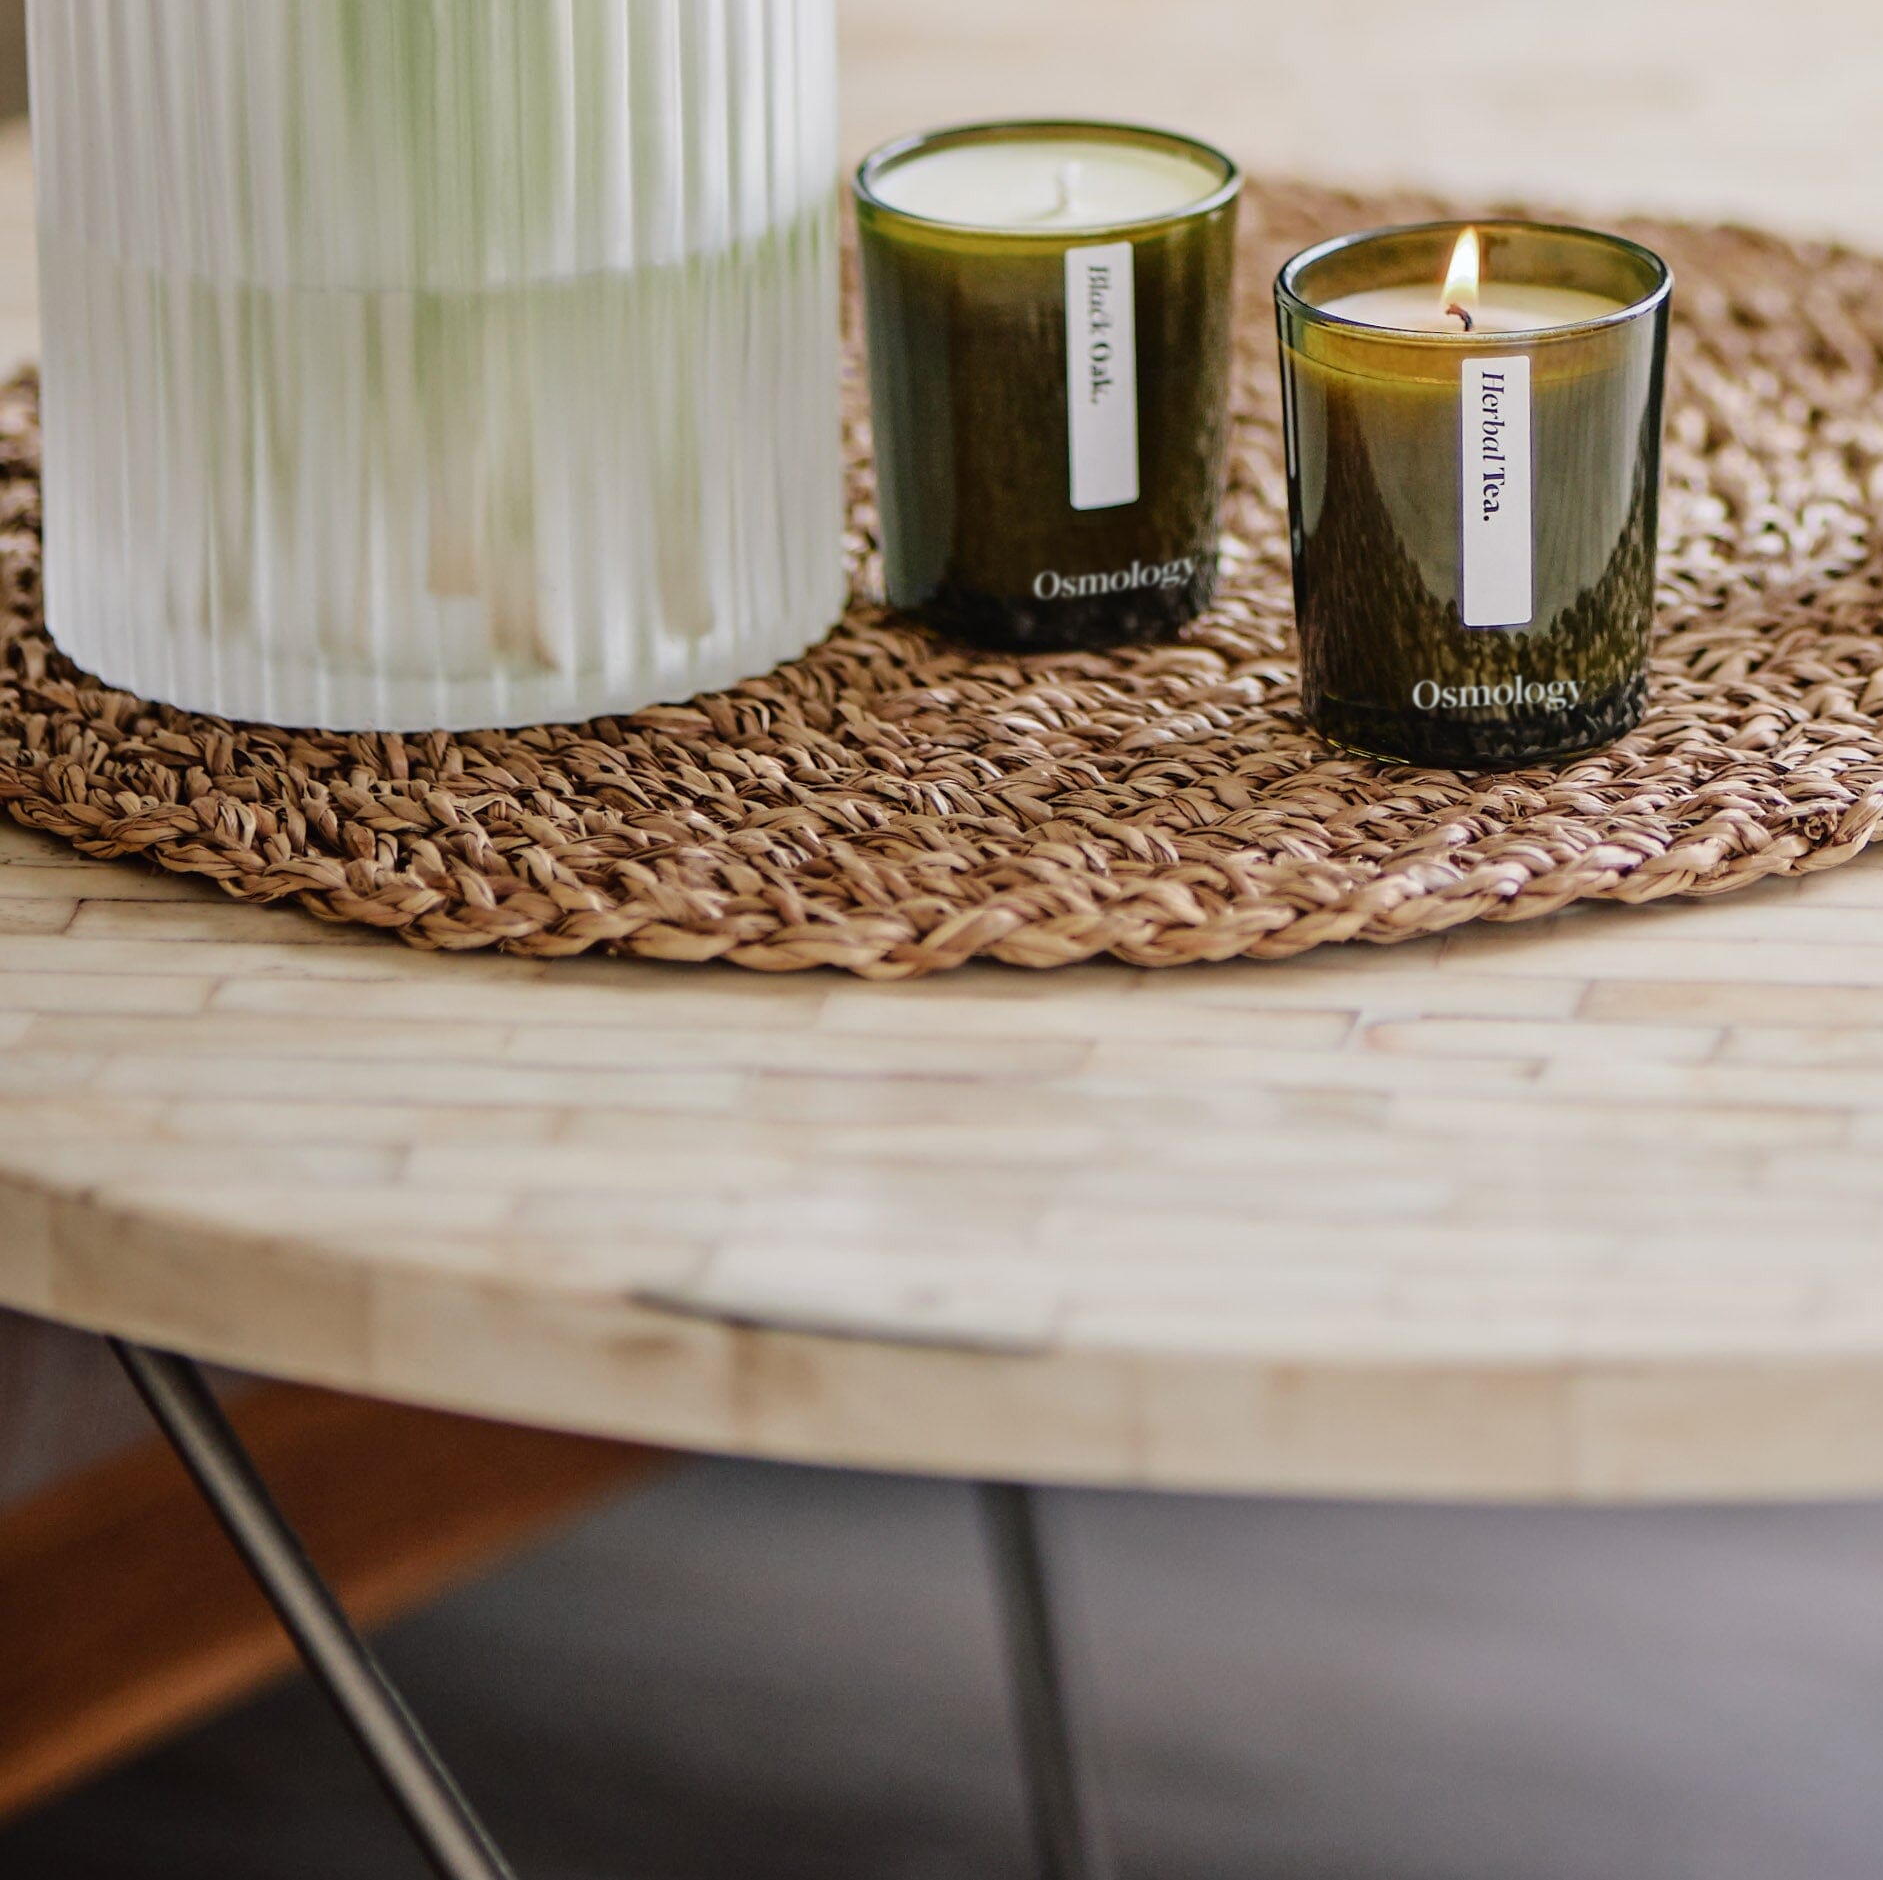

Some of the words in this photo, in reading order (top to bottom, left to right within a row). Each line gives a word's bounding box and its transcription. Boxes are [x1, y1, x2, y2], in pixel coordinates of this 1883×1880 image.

[1088, 266, 1113, 335] Black
[1089, 341, 1113, 404] Oak.
[1482, 371, 1506, 462] Herbal
[1483, 467, 1506, 522] Tea.
[1033, 555, 1199, 601] Osmology
[1412, 674, 1587, 711] Osmology
